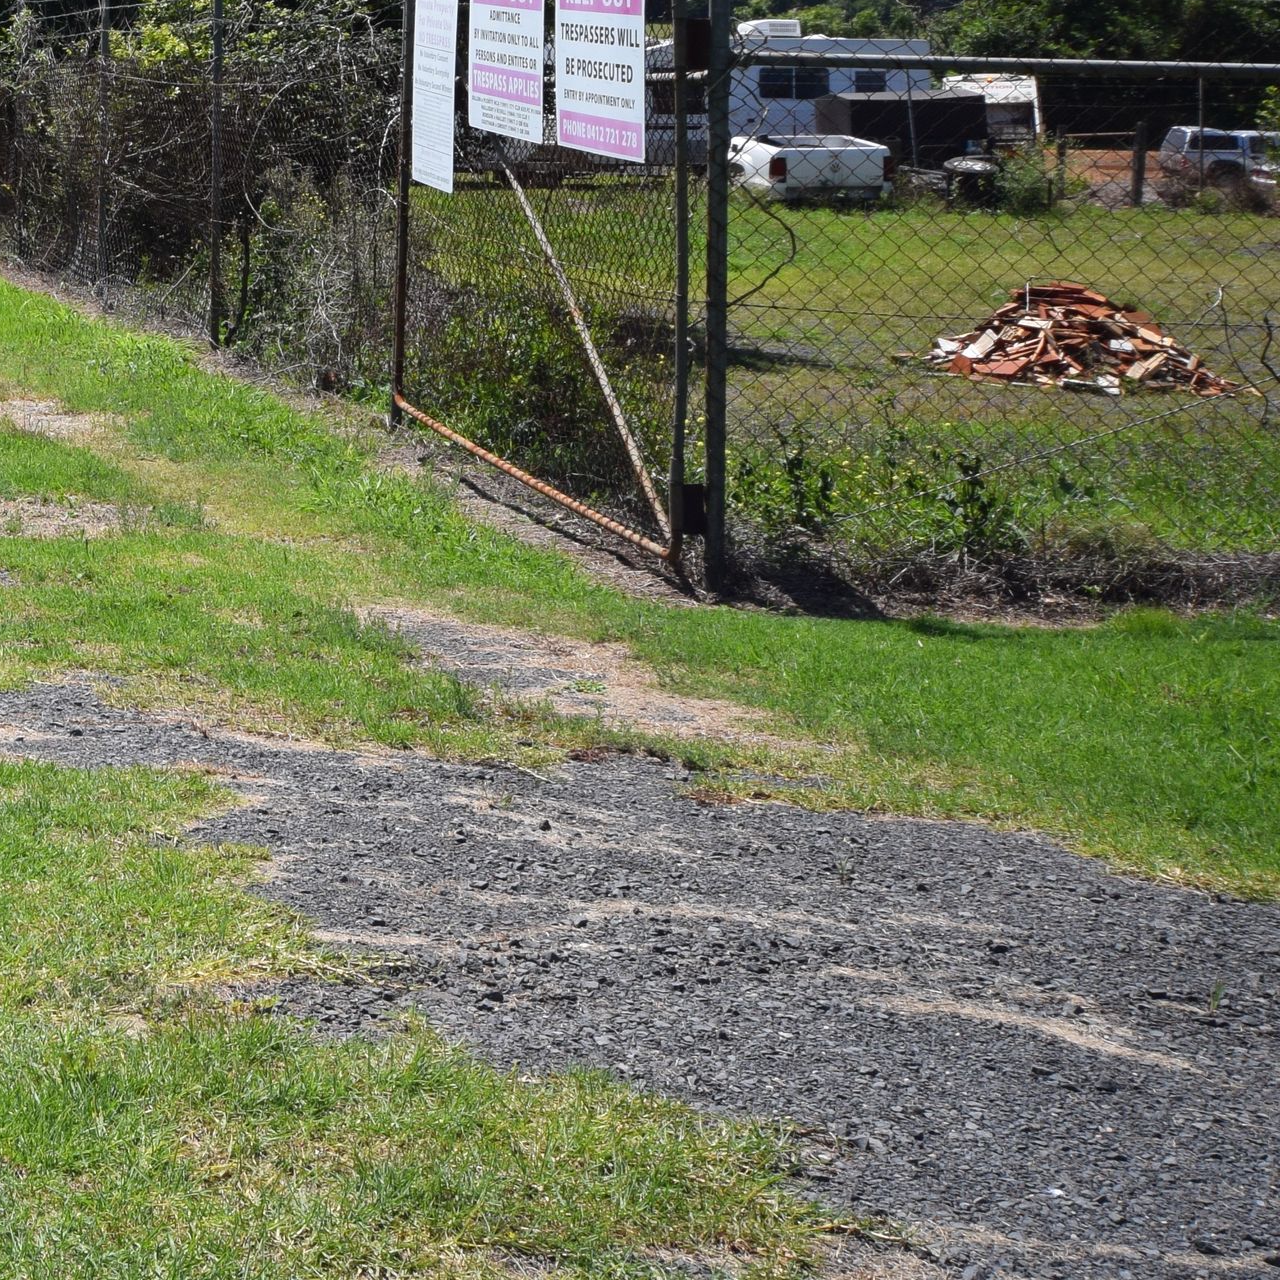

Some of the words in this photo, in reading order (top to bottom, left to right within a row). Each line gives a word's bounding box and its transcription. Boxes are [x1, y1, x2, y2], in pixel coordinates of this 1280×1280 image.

[489, 10, 521, 24] ADMITTANCE
[480, 29, 506, 44] INVITATION
[507, 33, 521, 46] ONLY
[521, 35, 528, 47] TO
[529, 36, 539, 49] ALL
[561, 23, 615, 45] TRESPASSERS
[617, 28, 640, 48] WILL
[475, 49, 496, 63] PERSONS
[497, 52, 507, 65] AND
[529, 58, 537, 70] OR
[565, 57, 574, 75] BE
[577, 59, 633, 83] PROSECUTED
[473, 69, 507, 93] TRESPASS
[508, 76, 539, 98] APPLIES
[564, 88, 578, 99] ENTRY
[579, 90, 585, 101] BY
[585, 92, 620, 108] APPOINTMENT
[621, 97, 636, 110] ONLY
[562, 119, 586, 138] PHONE
[587, 124, 604, 142] 0412
[605, 127, 620, 145] 721
[621, 130, 638, 148] 278
